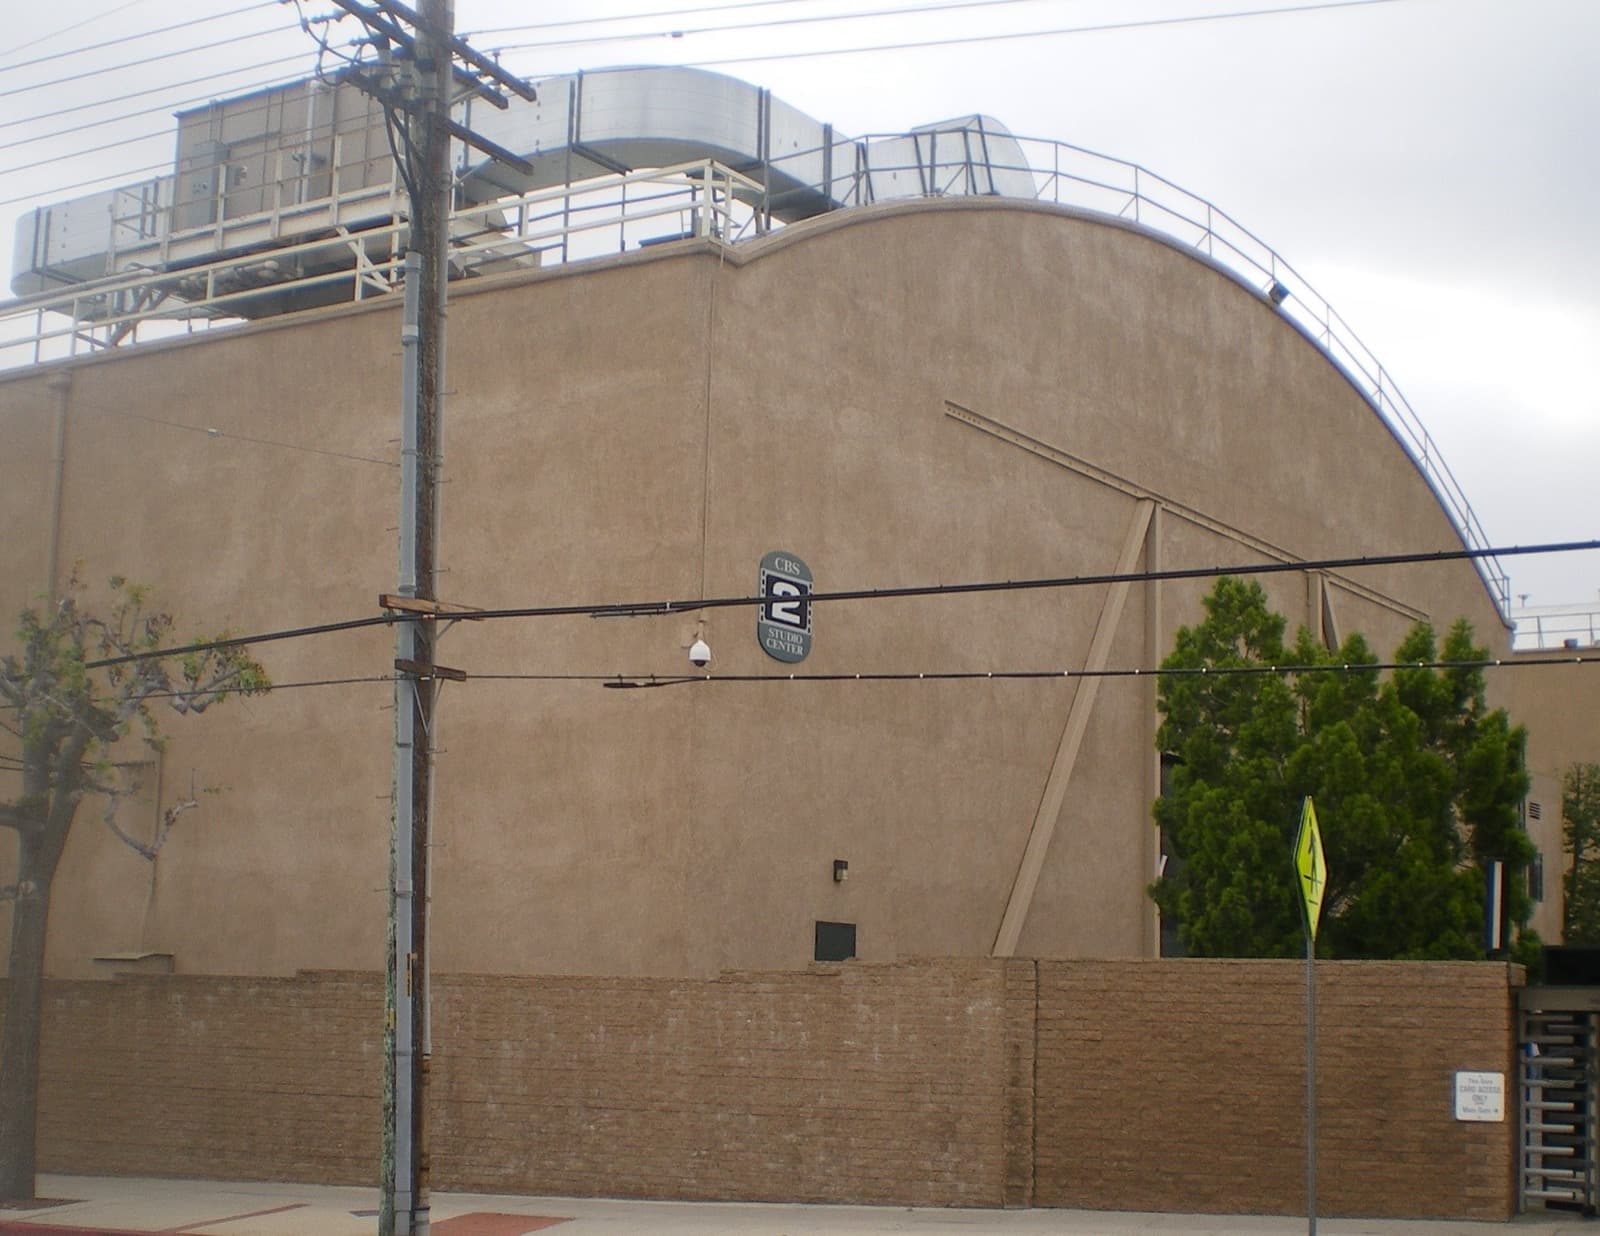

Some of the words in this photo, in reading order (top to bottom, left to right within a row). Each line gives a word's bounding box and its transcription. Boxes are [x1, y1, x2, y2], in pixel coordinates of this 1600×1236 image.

[774, 557, 801, 576] CBS
[771, 581, 801, 625] 2
[768, 627, 803, 644] STUDIO
[766, 637, 803, 656] CENTER
